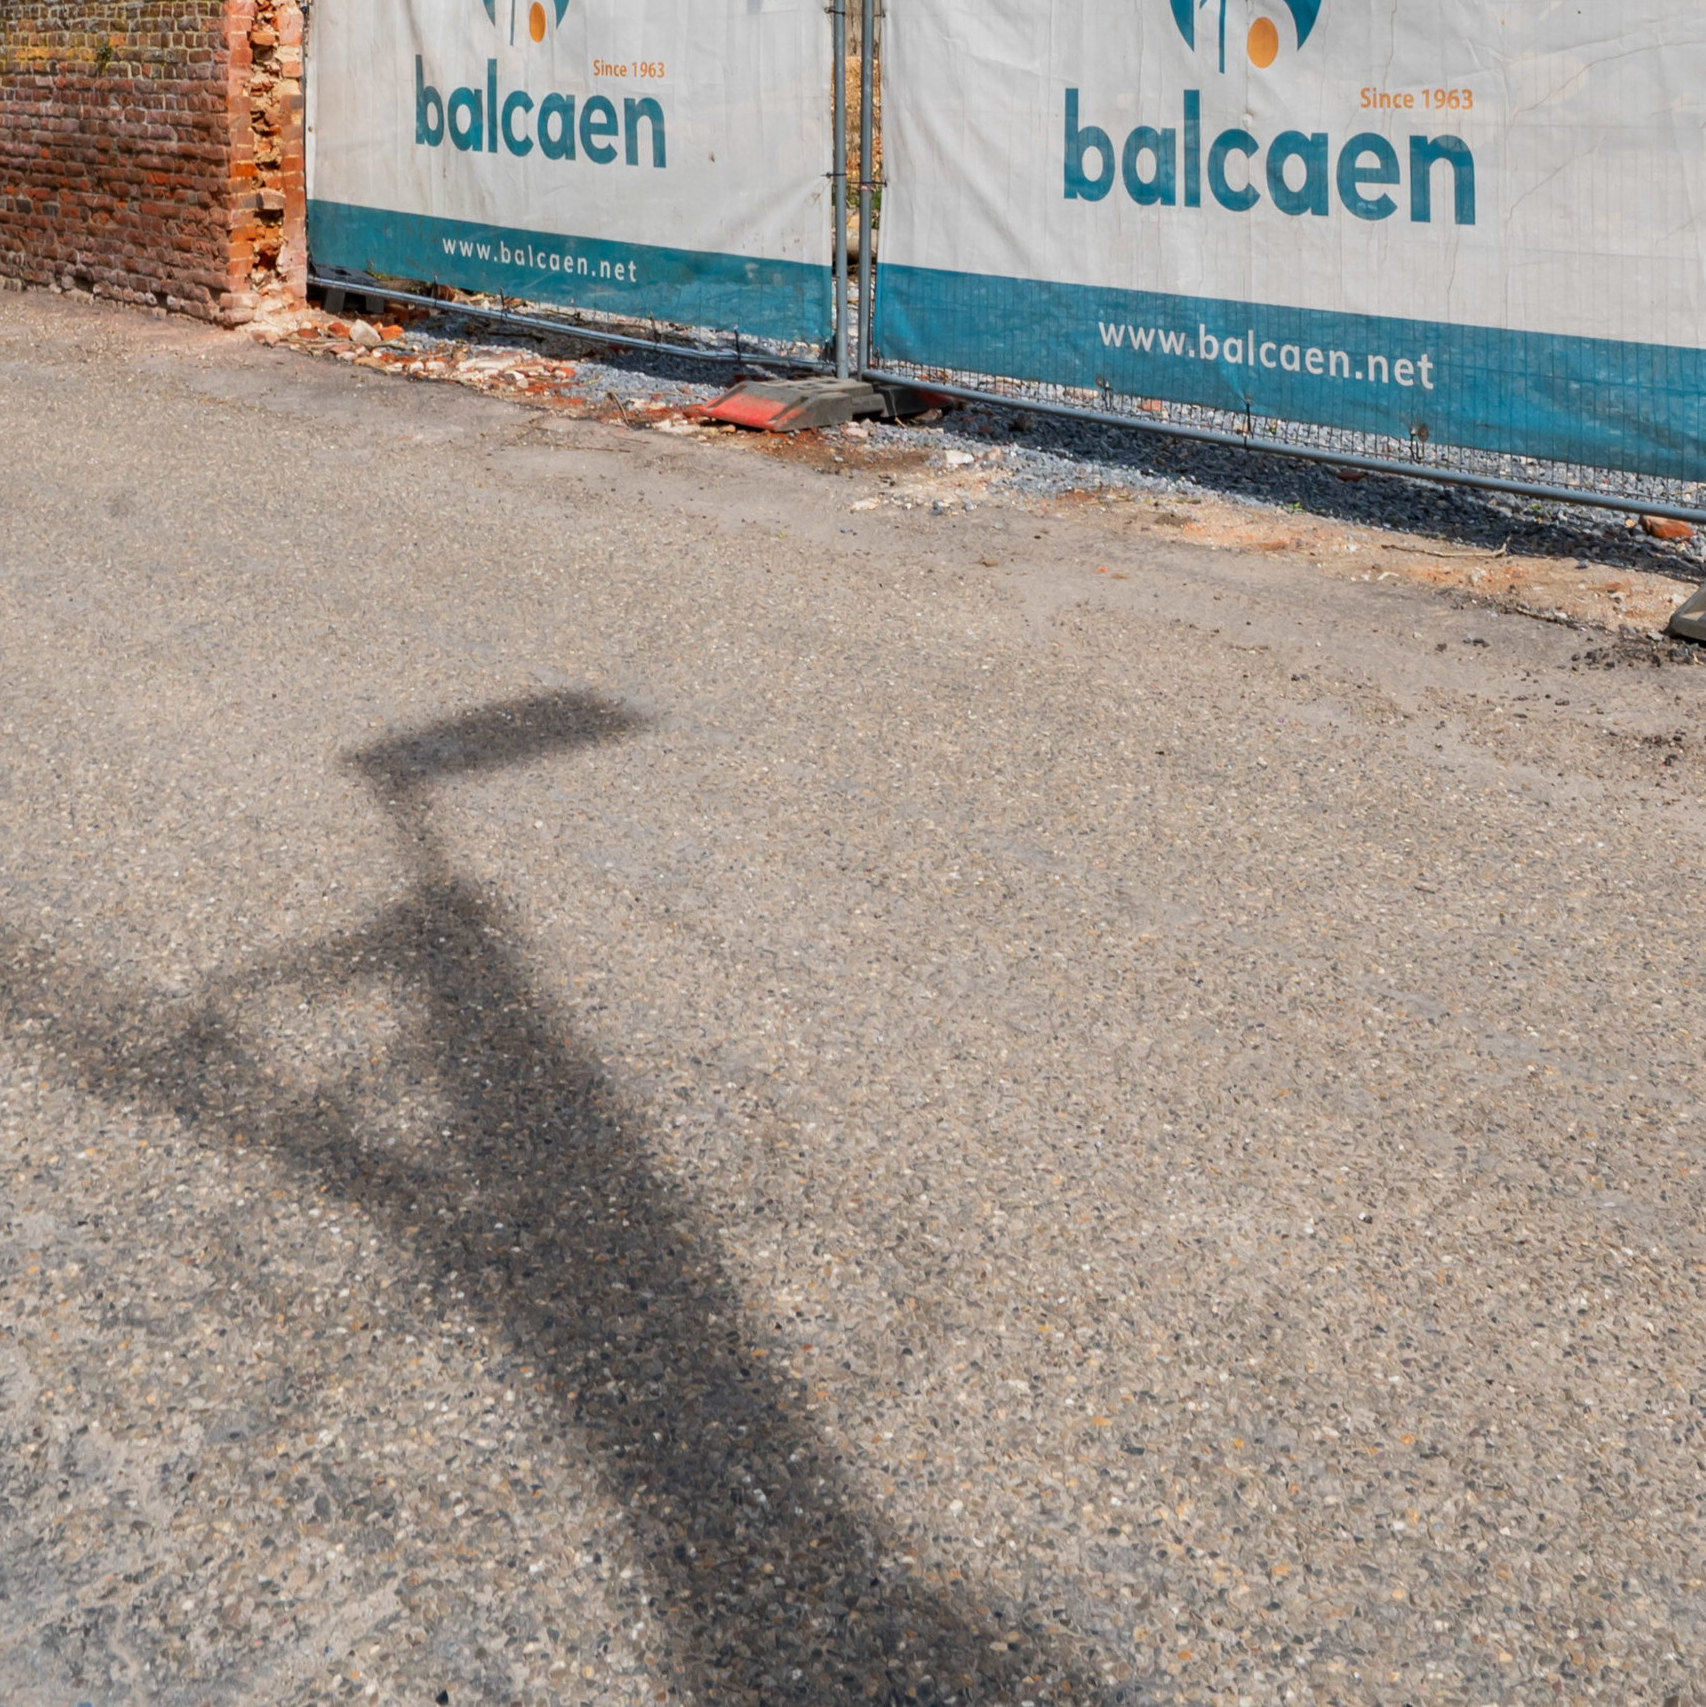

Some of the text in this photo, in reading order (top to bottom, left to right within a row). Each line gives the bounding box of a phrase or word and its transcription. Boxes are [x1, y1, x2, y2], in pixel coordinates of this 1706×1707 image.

[593, 59, 665, 79] Since 1963
[415, 54, 666, 168] balcaen
[1360, 87, 1474, 111] Since 1963
[1063, 87, 1476, 225] balcaen
[442, 237, 637, 283] www.balcaen.net
[1098, 321, 1434, 390] www.balcaen.net
